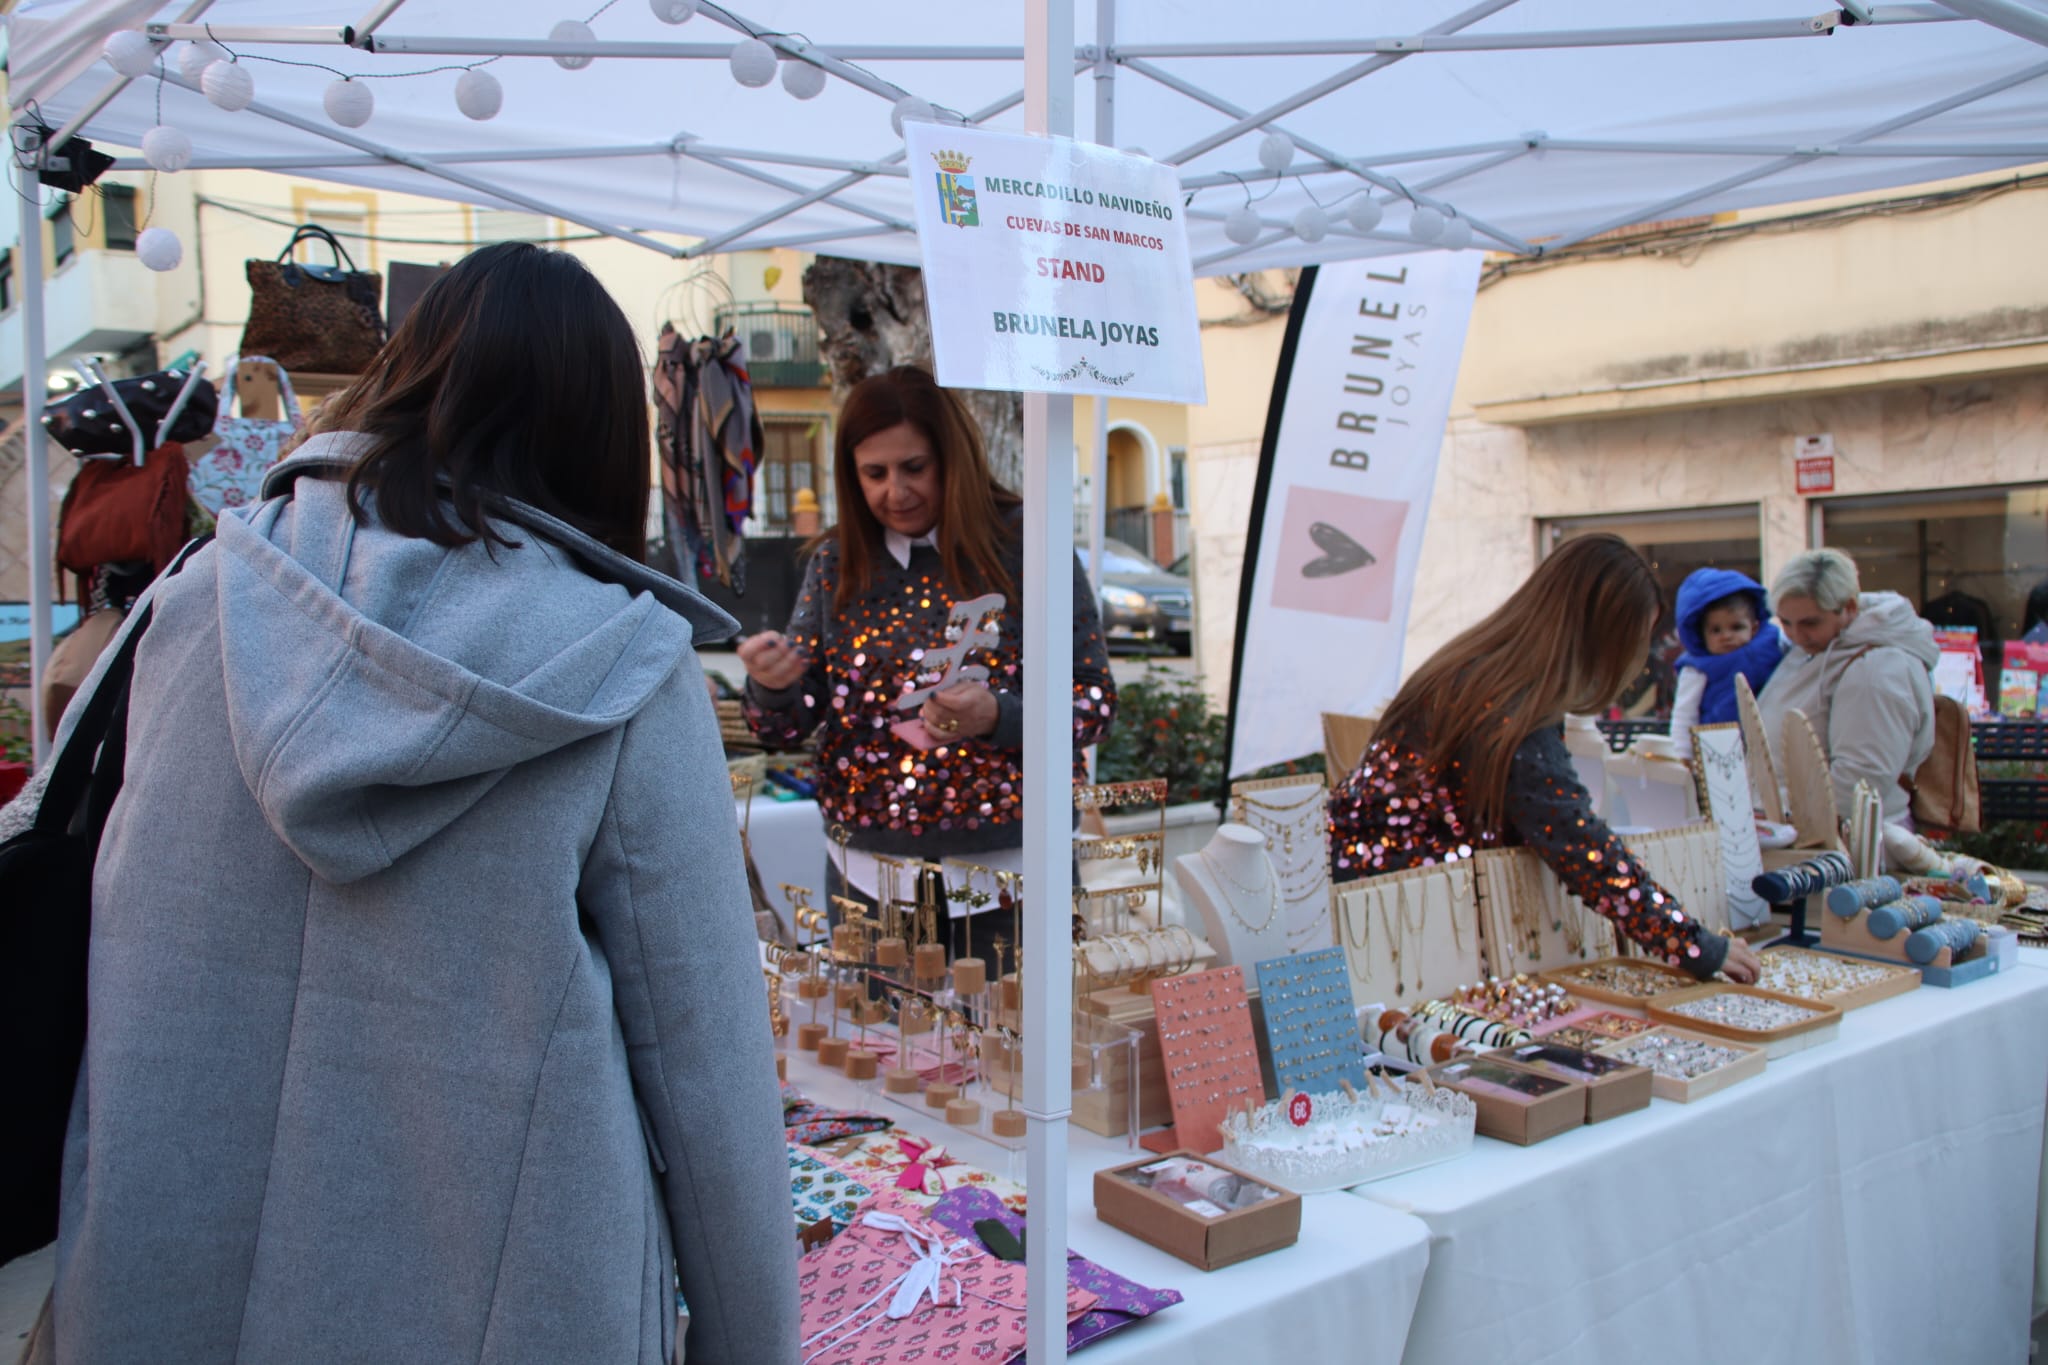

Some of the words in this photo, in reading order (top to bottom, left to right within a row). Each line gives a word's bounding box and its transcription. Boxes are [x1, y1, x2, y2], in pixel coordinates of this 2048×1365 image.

[985, 176, 1094, 205] MERCADILLO
[1098, 191, 1173, 221] NAVIDEÑO
[1006, 215, 1062, 235] CUEVAS
[1064, 222, 1082, 237] DE
[1084, 226, 1111, 242] SAN
[1113, 230, 1164, 251] MARCOS
[1037, 257, 1106, 284] STAND
[993, 311, 1097, 340] BRUNELA
[1100, 321, 1160, 347] JOYAS
[1386, 303, 1427, 428] JOYAS
